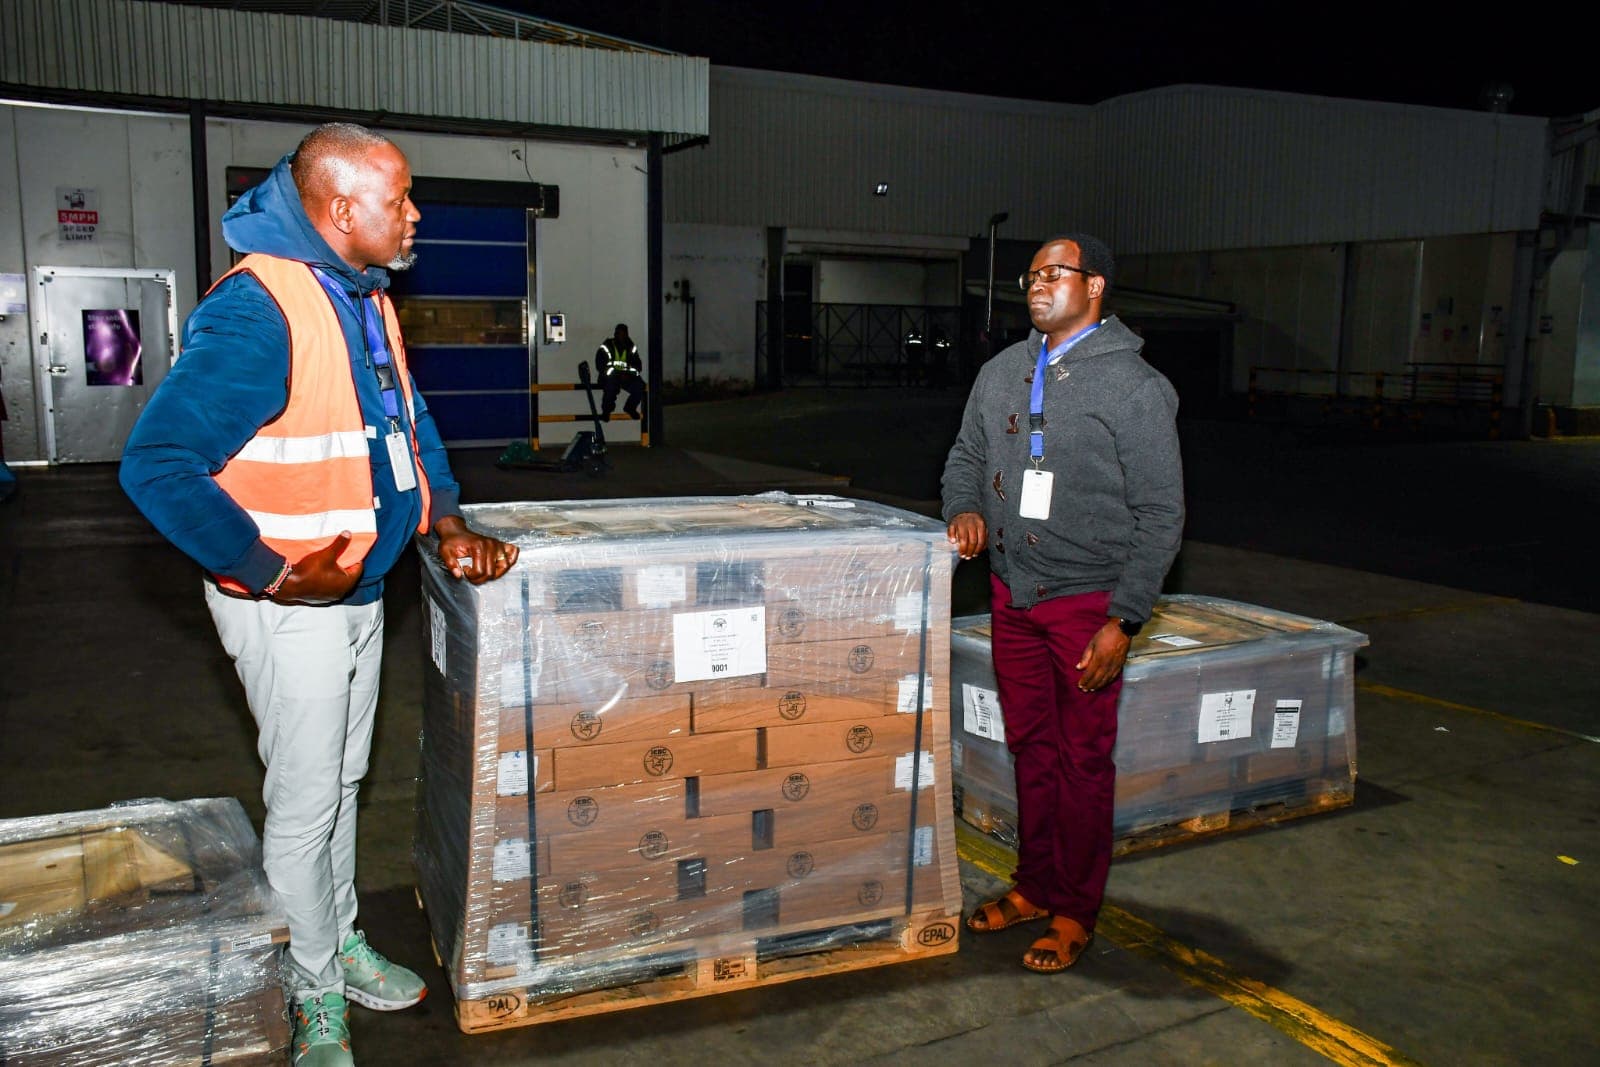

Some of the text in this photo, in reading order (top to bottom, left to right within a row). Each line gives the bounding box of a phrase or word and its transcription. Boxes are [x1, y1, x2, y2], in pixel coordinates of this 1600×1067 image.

[60, 212, 96, 223] 5MPH
[63, 225, 95, 233] SPEED
[711, 663, 728, 673] 0001
[650, 748, 667, 756] IEBC
[922, 927, 951, 944] EPAL
